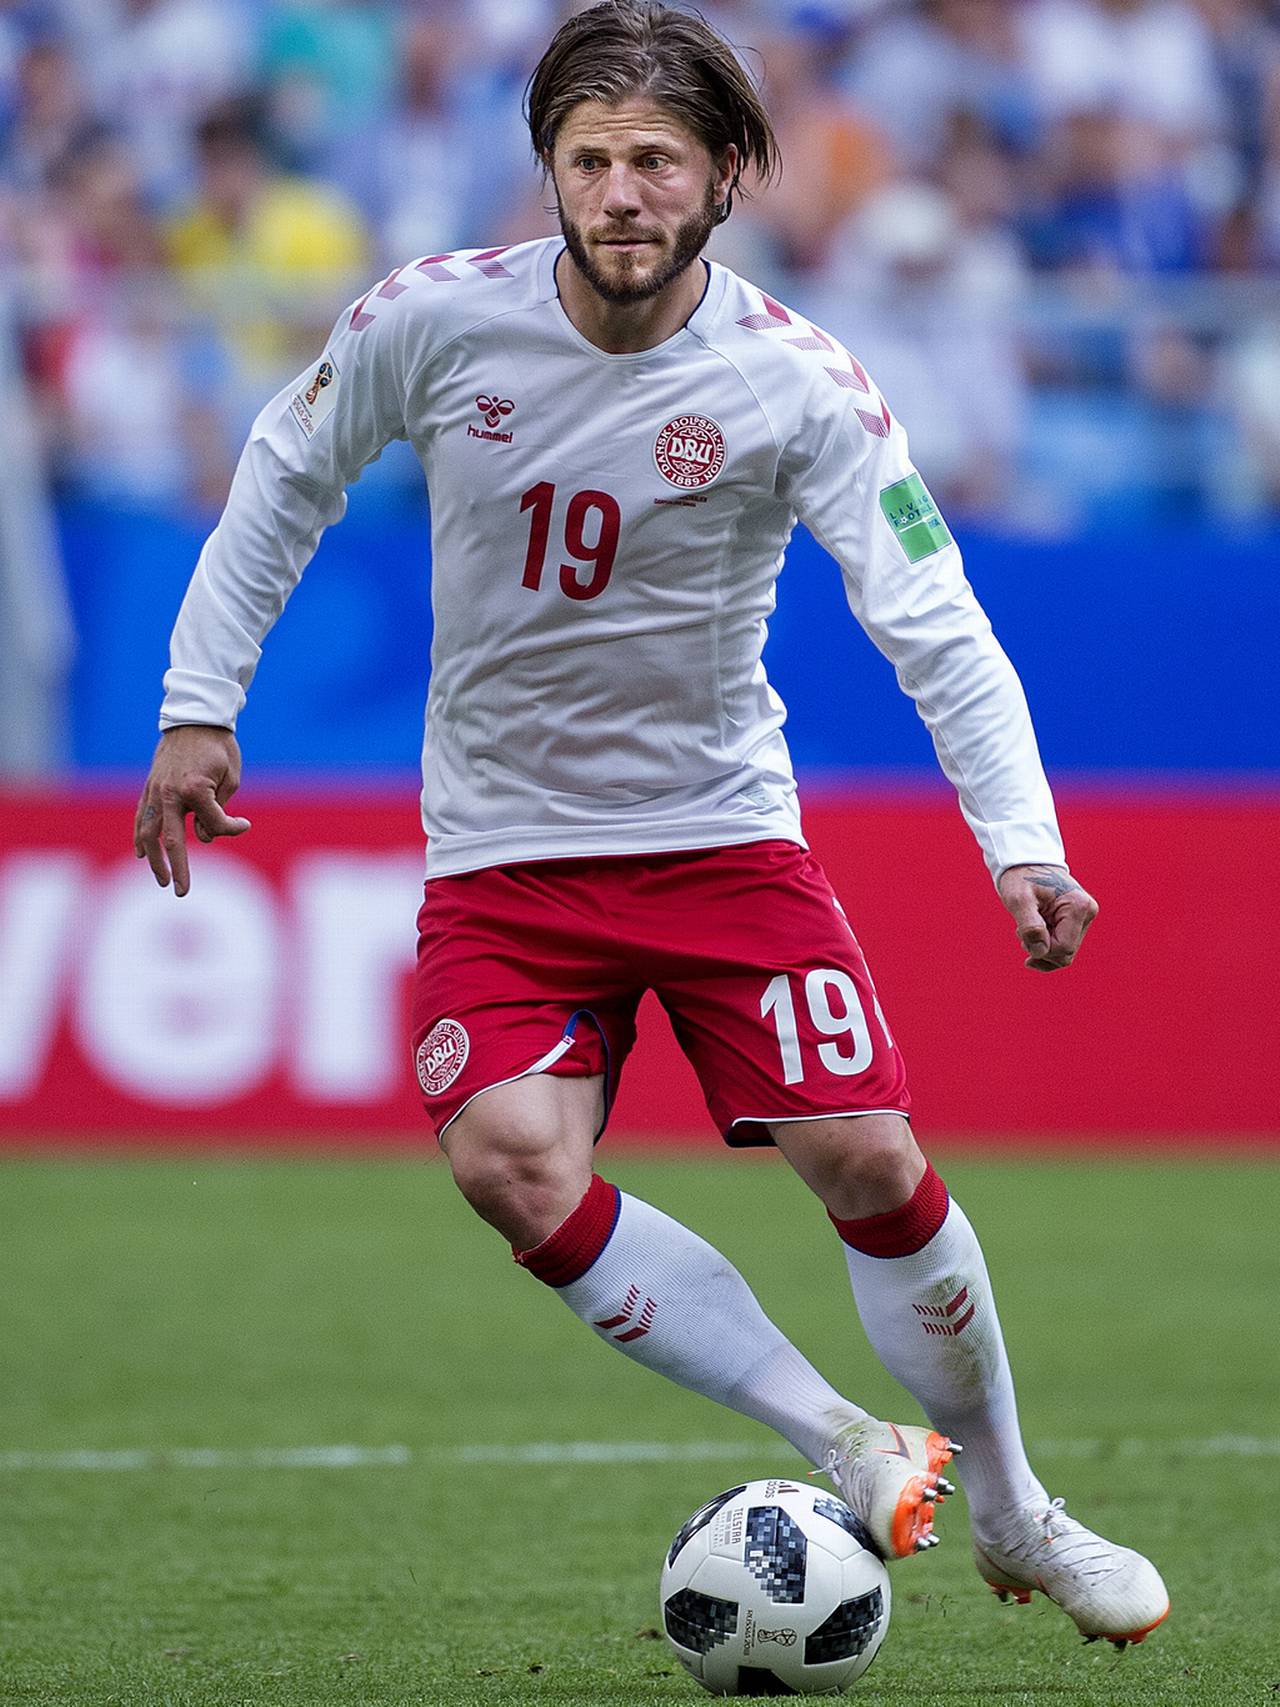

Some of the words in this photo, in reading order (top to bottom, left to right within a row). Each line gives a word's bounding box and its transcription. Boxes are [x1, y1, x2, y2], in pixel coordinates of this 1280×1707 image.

[467, 424, 513, 443] hummel
[668, 436, 713, 464] DBU
[656, 429, 672, 473] DANSK
[703, 443, 724, 481] UNION
[670, 473, 700, 486] 1889
[889, 495, 929, 520] LIVG
[519, 479, 621, 602] 19
[759, 968, 874, 1086] 19
[425, 1037, 456, 1076] DBU
[731, 1507, 744, 1545] TELSTRA
